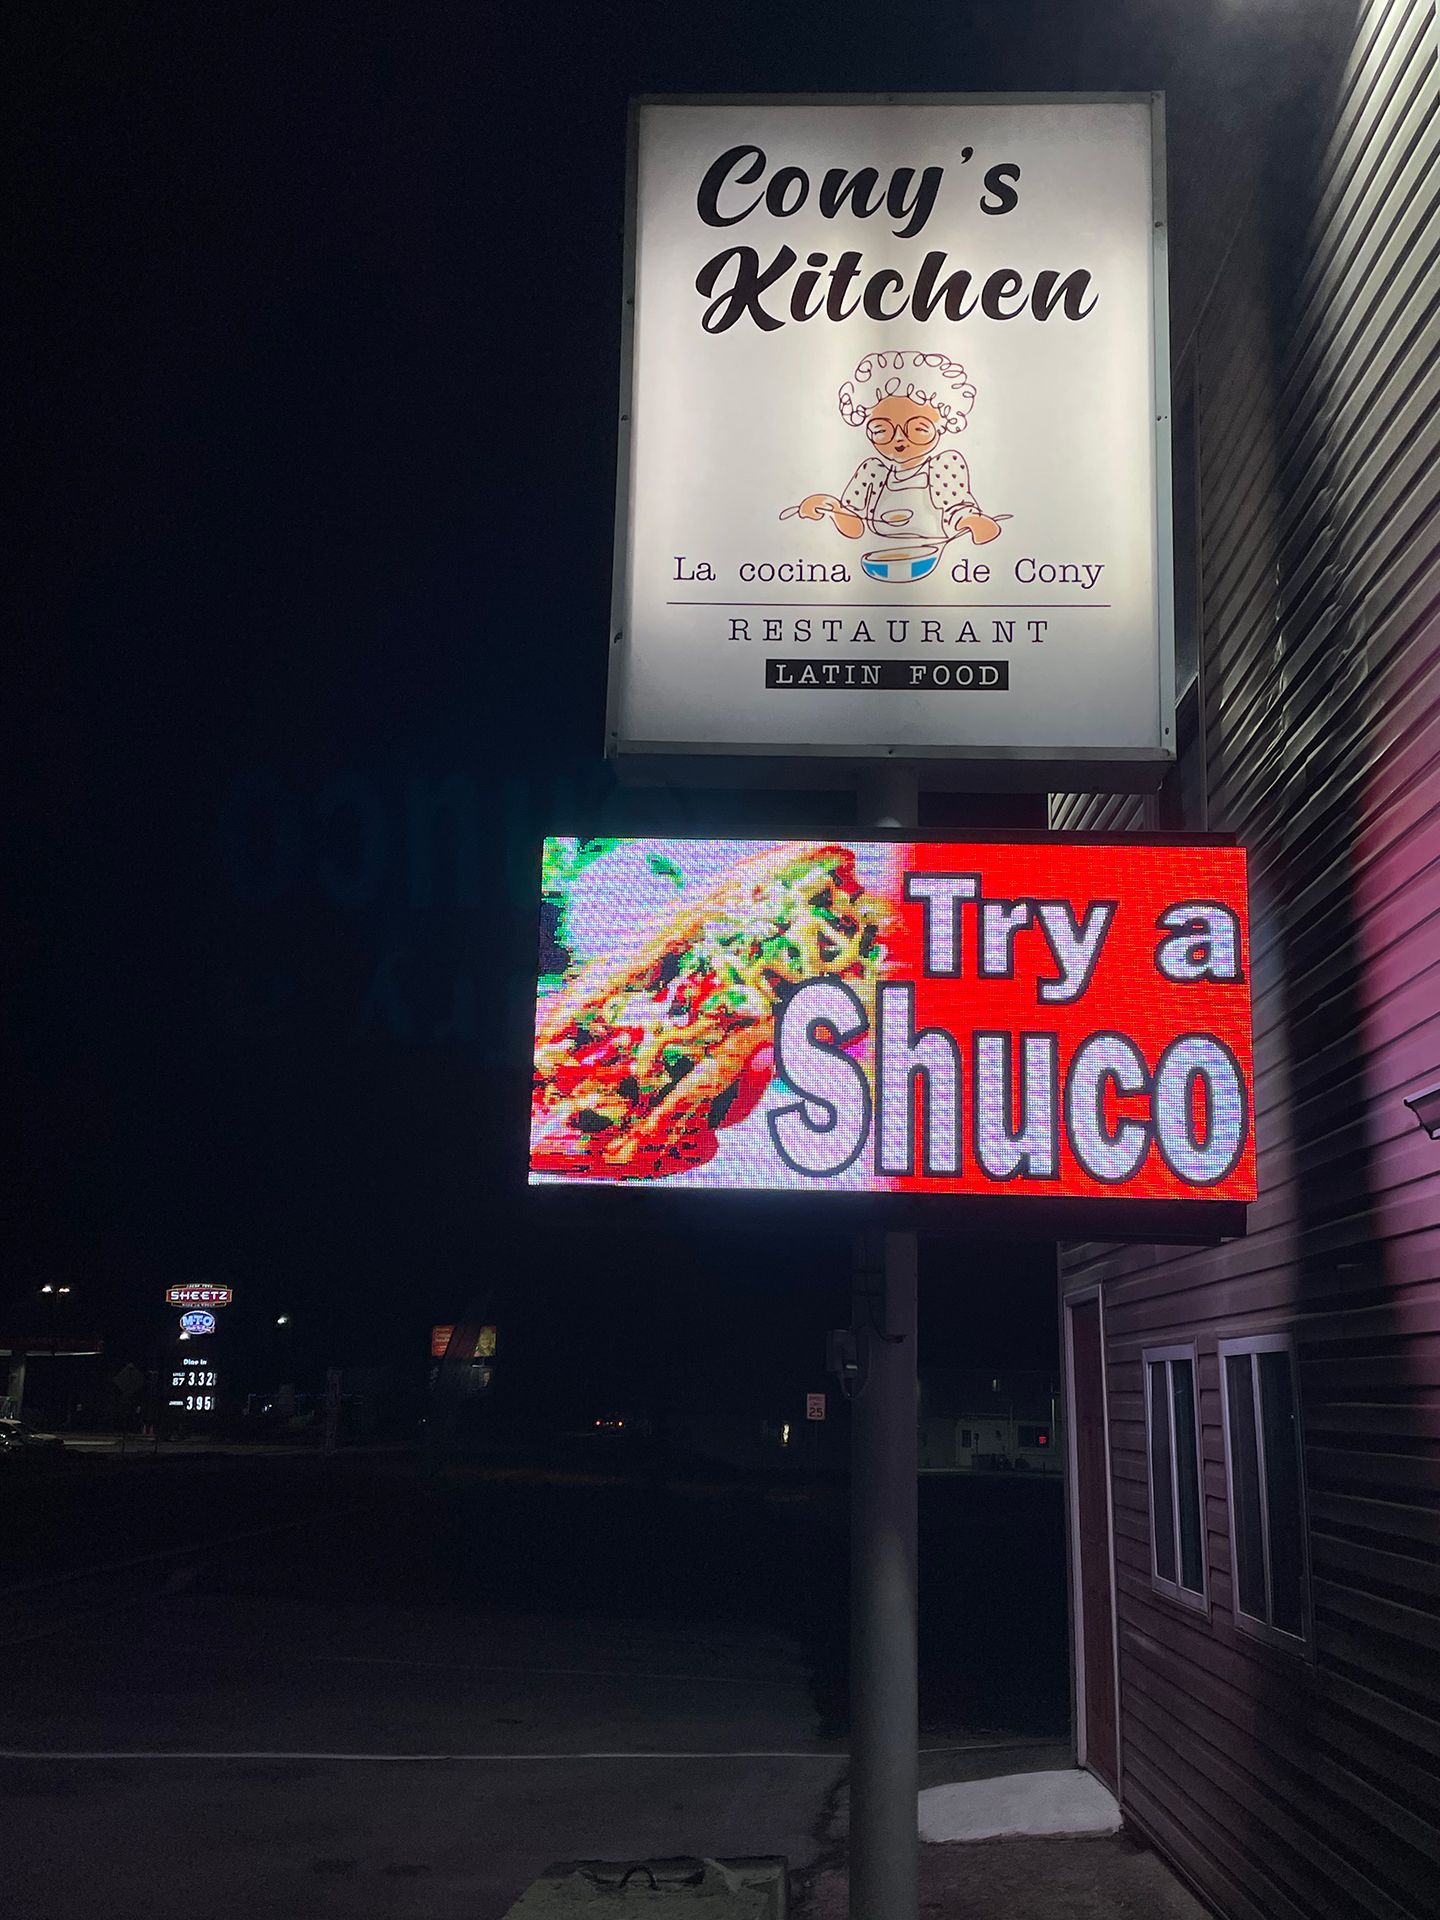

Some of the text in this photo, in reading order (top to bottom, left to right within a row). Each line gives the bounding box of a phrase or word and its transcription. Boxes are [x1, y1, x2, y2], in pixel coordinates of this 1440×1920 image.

[697, 144, 1021, 239] Cony's
[695, 244, 1100, 335] Kitchen
[673, 556, 1105, 589] La cocina de Cony
[727, 618, 1048, 643] RESTAURANT
[775, 664, 999, 685] LATIN FOOD
[903, 871, 1245, 1005] Try a
[767, 975, 1247, 1187] Shuco
[170, 1291, 228, 1300] SHEETZ
[172, 1377, 185, 1386] 87
[809, 1407, 823, 1418] 25
